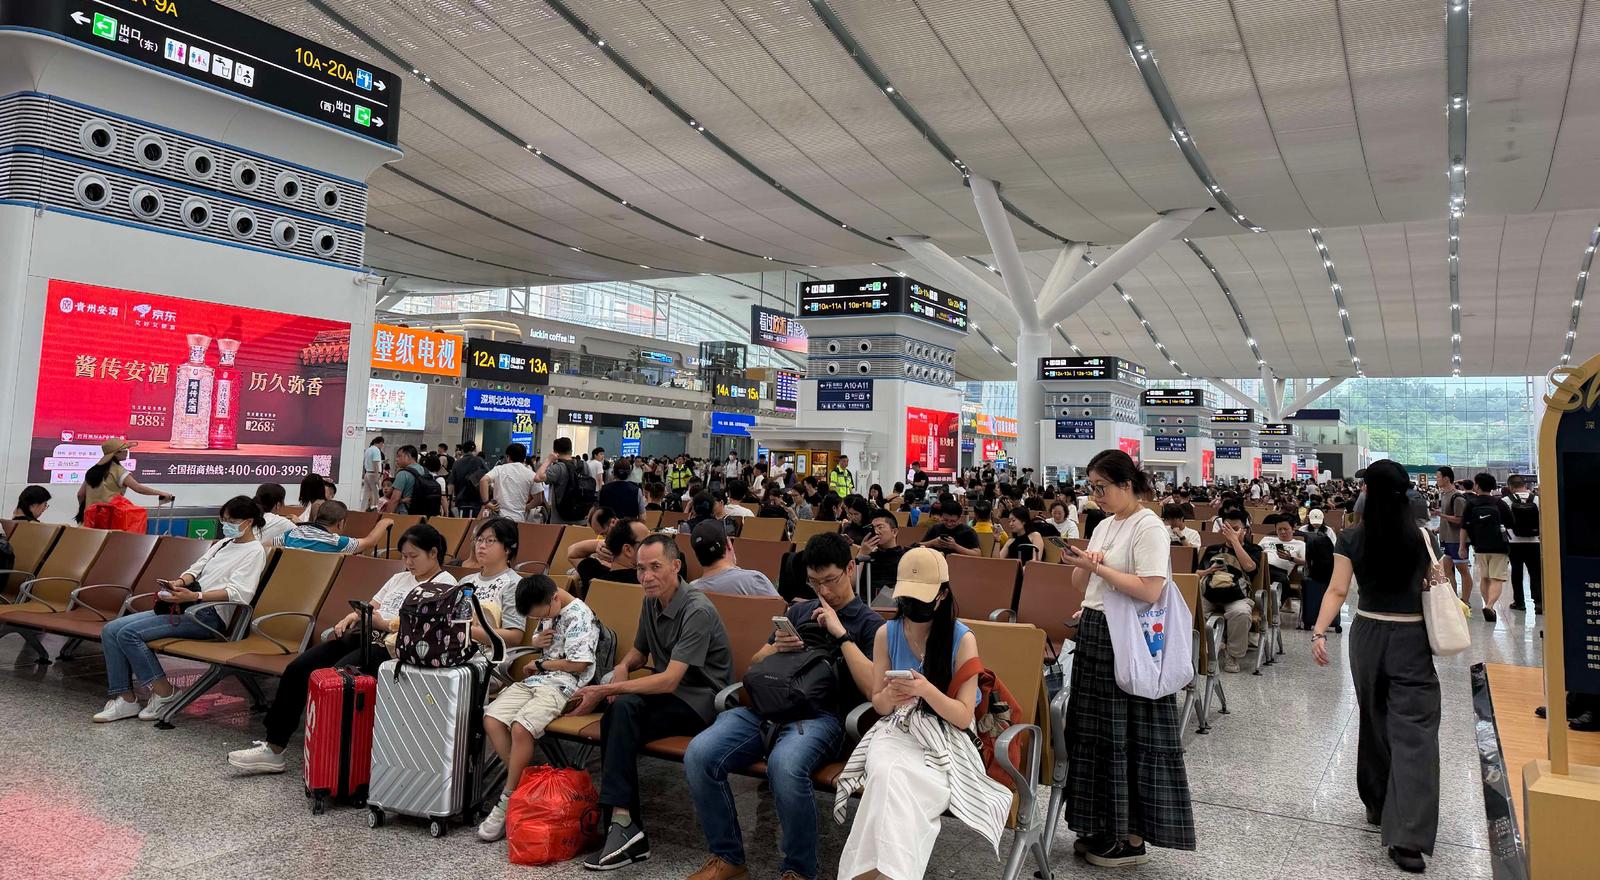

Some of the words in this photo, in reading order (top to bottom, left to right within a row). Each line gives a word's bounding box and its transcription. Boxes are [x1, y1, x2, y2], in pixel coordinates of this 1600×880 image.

[119, 24, 141, 40] 出口
[295, 47, 355, 84] 10A-20A
[335, 100, 351, 112] 出口
[152, 309, 177, 322] 京东
[530, 328, 549, 339] luckin
[549, 332, 567, 342] coffee
[374, 329, 456, 369] 壁纸电视
[473, 350, 496, 368] 12A
[529, 357, 549, 374] 13A
[75, 354, 170, 384] 酱传安酒
[248, 371, 324, 396] 历久弥香
[716, 384, 729, 396] 14A
[747, 387, 759, 400] 15A
[137, 414, 160, 427] 388
[251, 420, 271, 432] 268
[167, 463, 309, 476] 全国招商热线:400-600-3995
